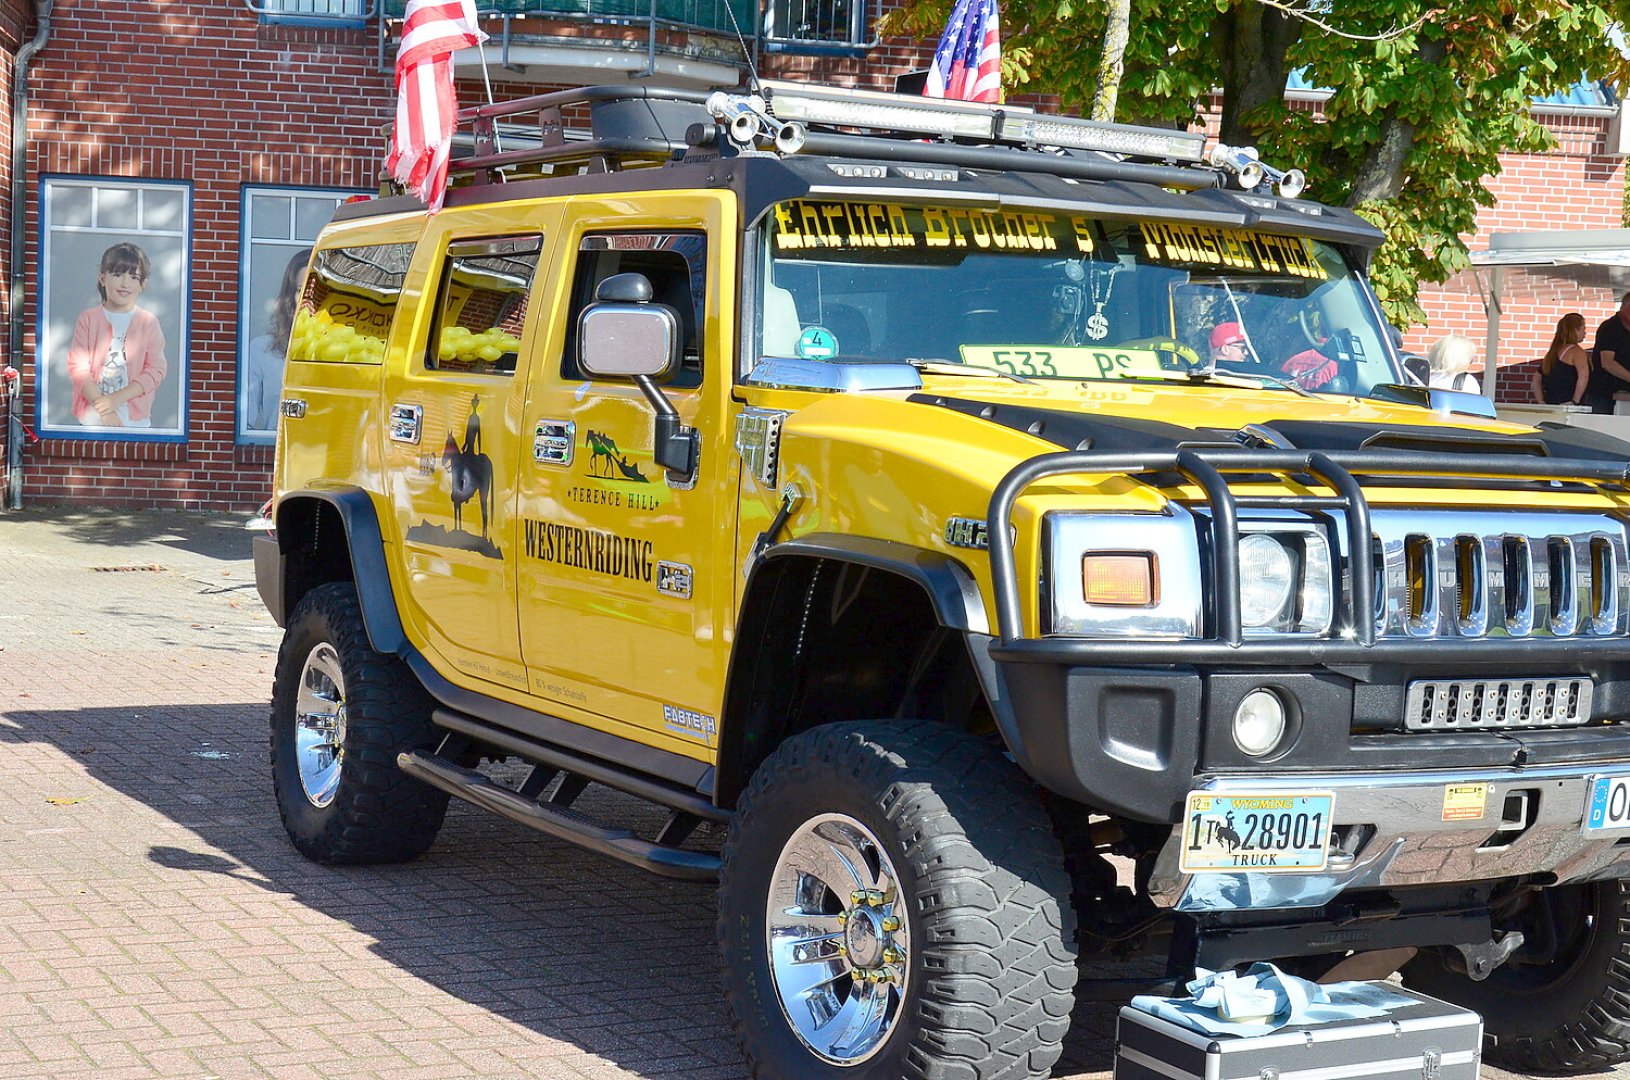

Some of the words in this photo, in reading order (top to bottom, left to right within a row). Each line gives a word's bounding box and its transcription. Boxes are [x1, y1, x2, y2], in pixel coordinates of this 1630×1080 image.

[812, 331, 823, 346] 4
[993, 351, 1057, 377] 533
[573, 487, 621, 507] TERENCE
[628, 493, 654, 511] HILL
[524, 518, 653, 583] WESTERNRIDING
[1231, 798, 1294, 810] WYOMING
[1609, 782, 1630, 822] O
[1593, 809, 1602, 821] D
[1241, 812, 1322, 851] 28901
[1232, 853, 1278, 866] TRUCK
